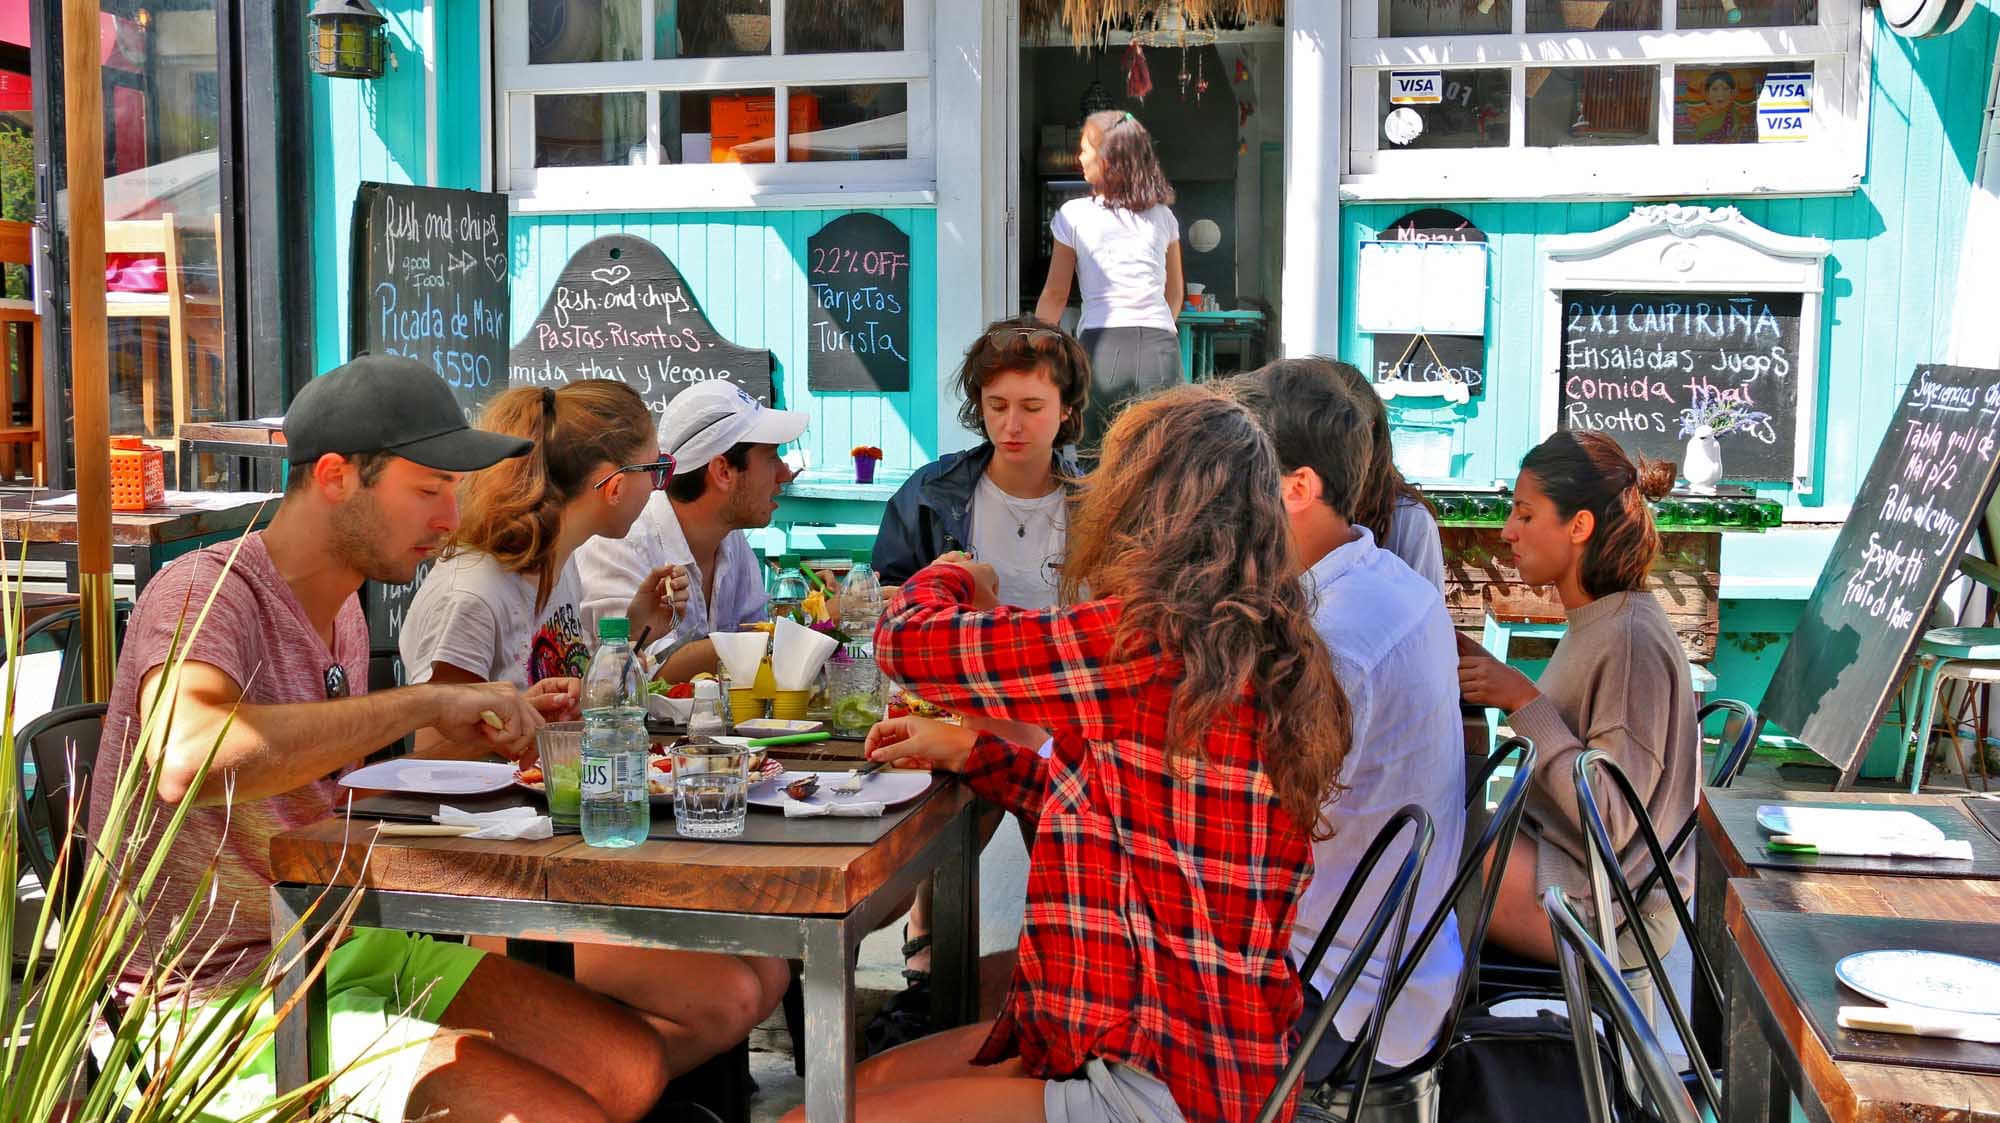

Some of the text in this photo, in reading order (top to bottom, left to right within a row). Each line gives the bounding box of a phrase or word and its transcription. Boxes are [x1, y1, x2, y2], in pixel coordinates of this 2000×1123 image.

[1399, 79, 1434, 92] VISA
[1766, 84, 1805, 97] VISA
[1766, 116, 1802, 129] VISA
[385, 196, 420, 275] fish
[460, 203, 499, 262] chips
[402, 249, 432, 280] good
[814, 247, 909, 281] 22% OFF
[375, 282, 504, 342] Picada de Mar
[554, 286, 597, 328] fish
[1566, 338, 1695, 373] Ensaladas
[637, 365, 652, 394] y
[1565, 402, 1666, 433] Risottos
[1904, 419, 1942, 456] Tabla
[1879, 484, 1913, 523] Pollo
